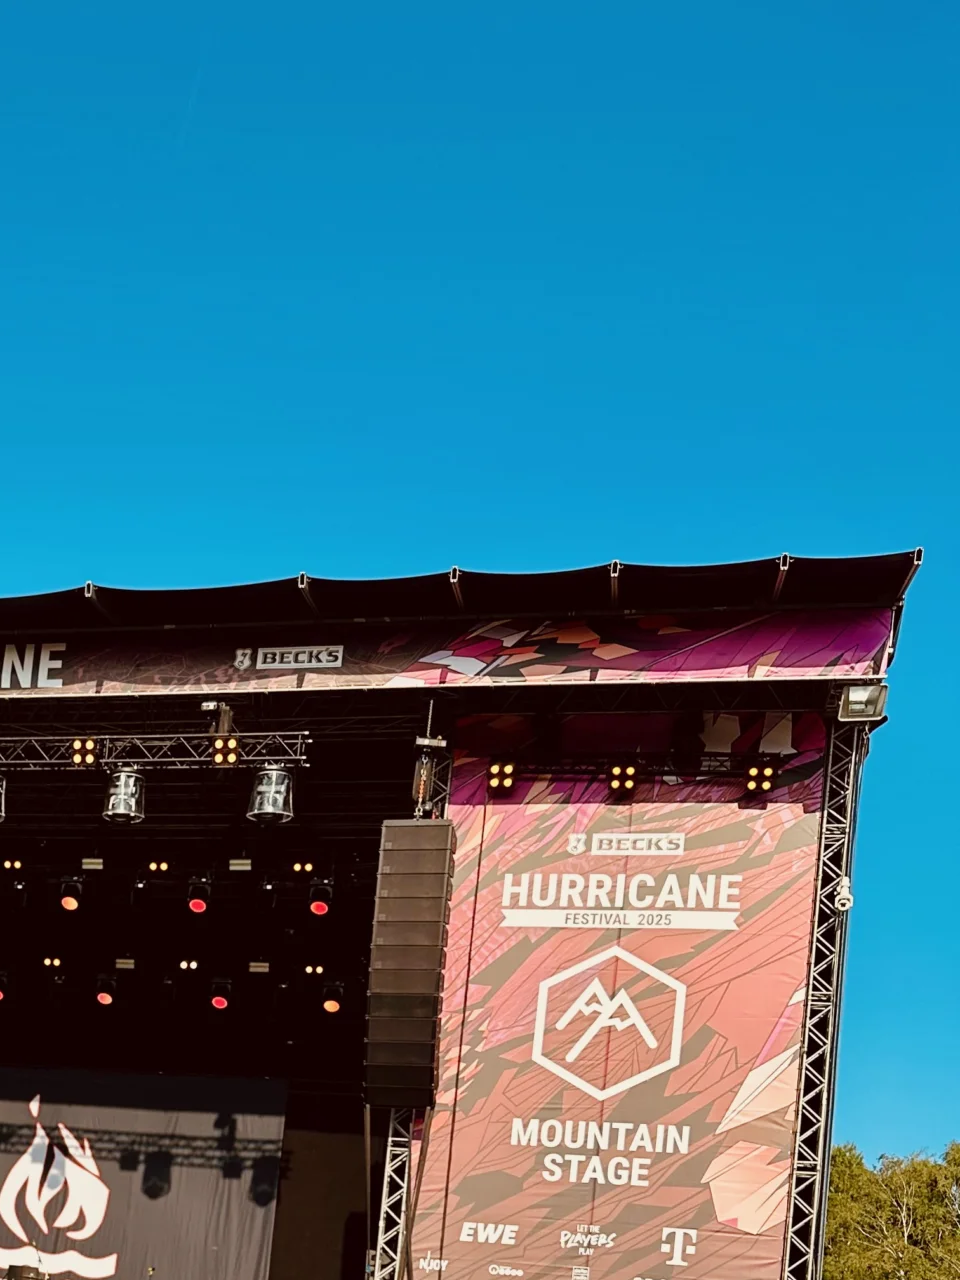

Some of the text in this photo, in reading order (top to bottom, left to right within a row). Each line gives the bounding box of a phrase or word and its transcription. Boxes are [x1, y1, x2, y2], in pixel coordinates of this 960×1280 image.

[261, 647, 340, 665] BECK'S
[596, 836, 681, 851] BECK'S
[501, 872, 743, 909] HURRICANE
[564, 912, 672, 926] FESTIVAL 2025
[510, 1118, 691, 1154] MOUNTAIN
[541, 1153, 651, 1187] STAGE
[459, 1221, 519, 1245] EWE
[560, 1230, 617, 1248] PLAYERS
[576, 1224, 600, 1233] LET THE
[660, 1226, 698, 1267] T
